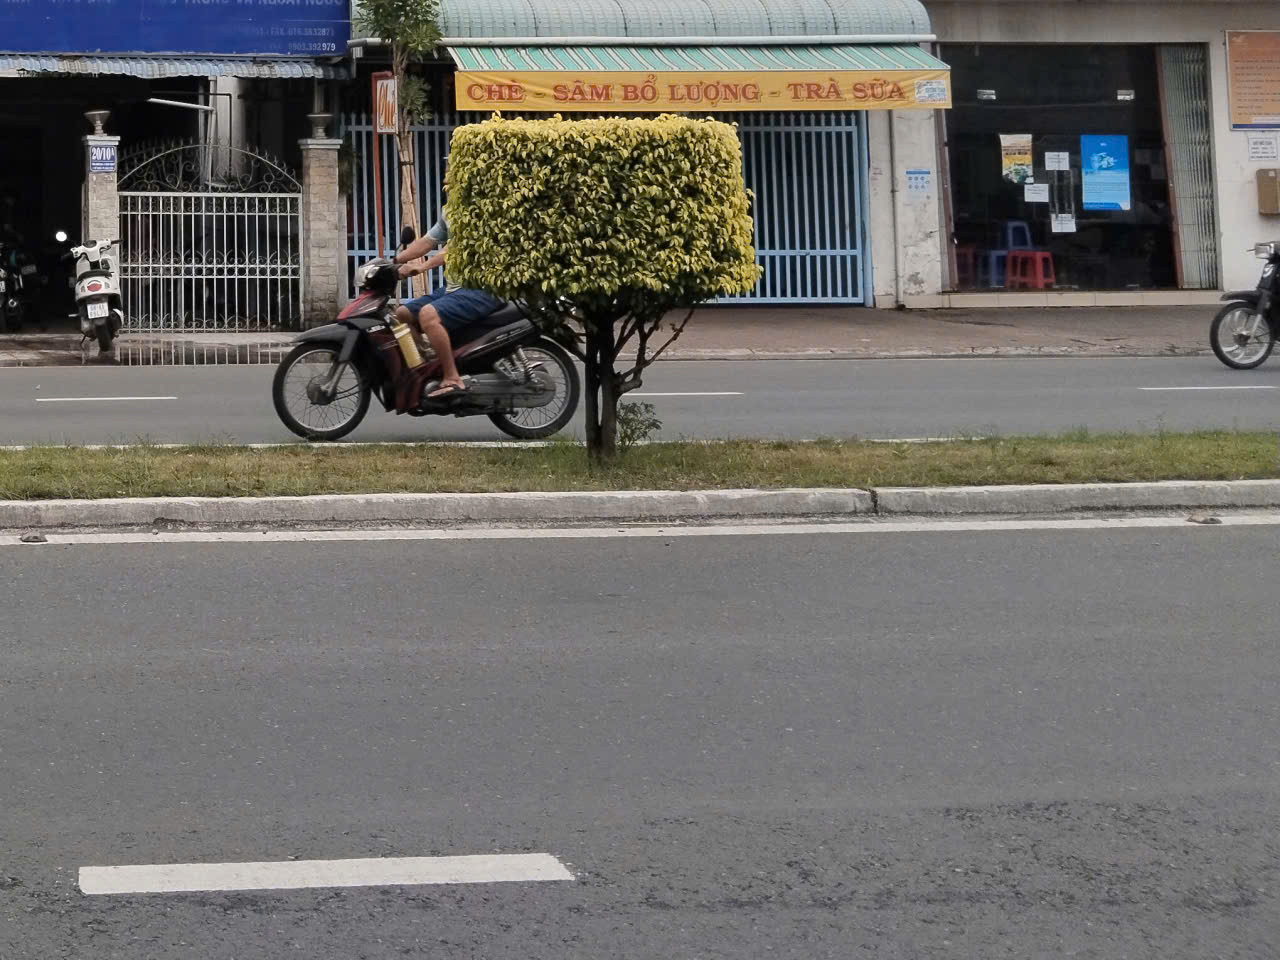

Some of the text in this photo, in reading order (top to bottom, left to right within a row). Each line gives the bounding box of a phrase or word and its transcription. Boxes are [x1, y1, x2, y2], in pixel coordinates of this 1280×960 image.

[466, 79, 525, 103] CHÈ
[552, 79, 615, 103] SÂM
[621, 73, 658, 103] BỔ
[668, 79, 761, 107] LƯỢNG
[788, 77, 845, 102] TRÀ
[852, 78, 907, 101] SỮA
